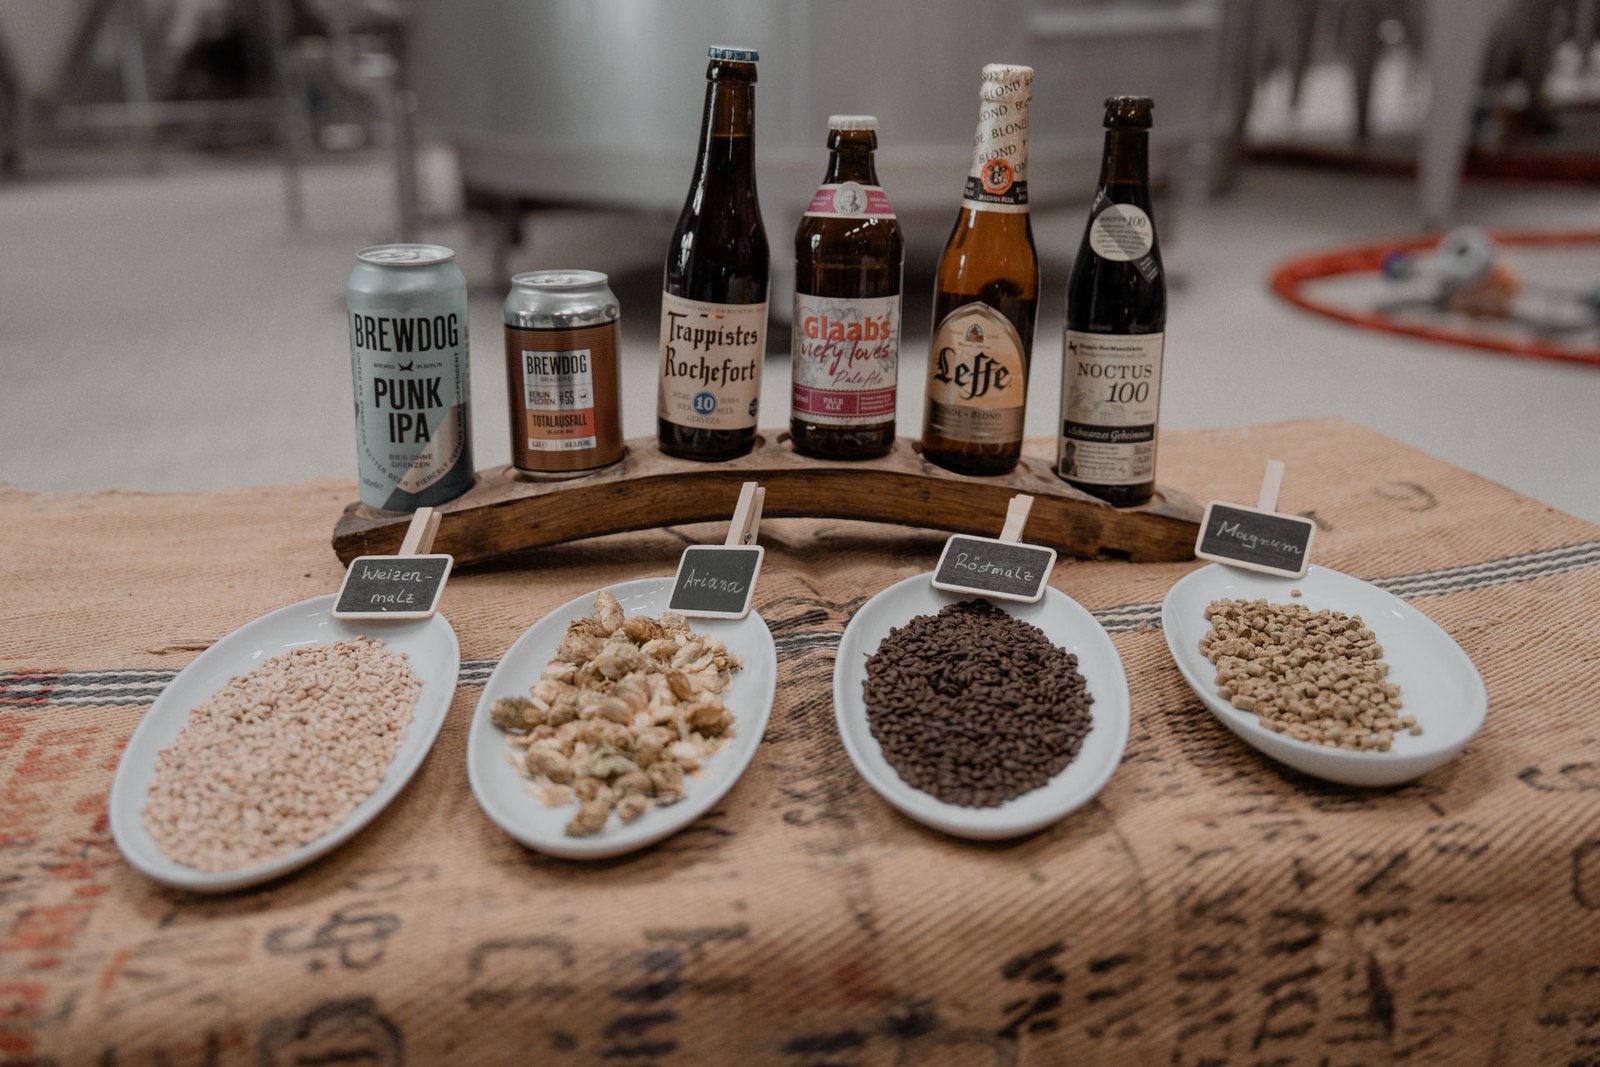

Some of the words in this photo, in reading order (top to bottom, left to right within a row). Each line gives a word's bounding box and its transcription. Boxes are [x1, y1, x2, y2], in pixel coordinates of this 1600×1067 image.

[984, 80, 1021, 101] BLOND
[991, 119, 1027, 139] BLOND
[978, 144, 1017, 164] BLOND
[354, 312, 459, 352] BREWDOG
[667, 310, 758, 352] Trappistes
[526, 354, 588, 376] BREWDOG
[664, 345, 757, 388] Rochefort
[934, 346, 1013, 400] Leffe
[1077, 361, 1153, 380] NOCTUS
[373, 376, 443, 410] PUNK
[558, 390, 576, 406] #55
[823, 396, 844, 405] PALE
[1105, 381, 1150, 404] 100
[694, 396, 715, 411] 10
[825, 403, 842, 411] ALE
[388, 412, 431, 443] IPA
[532, 413, 588, 428] TOTALAUSFALL
[686, 414, 720, 424] CERVEZA
[391, 461, 431, 469] GRENZEN
[415, 463, 449, 488] FIERCELY
[1216, 521, 1302, 554] Magnum
[954, 552, 1034, 582] Röstmalz
[683, 568, 744, 594] Ariana
[370, 588, 414, 604] malz
